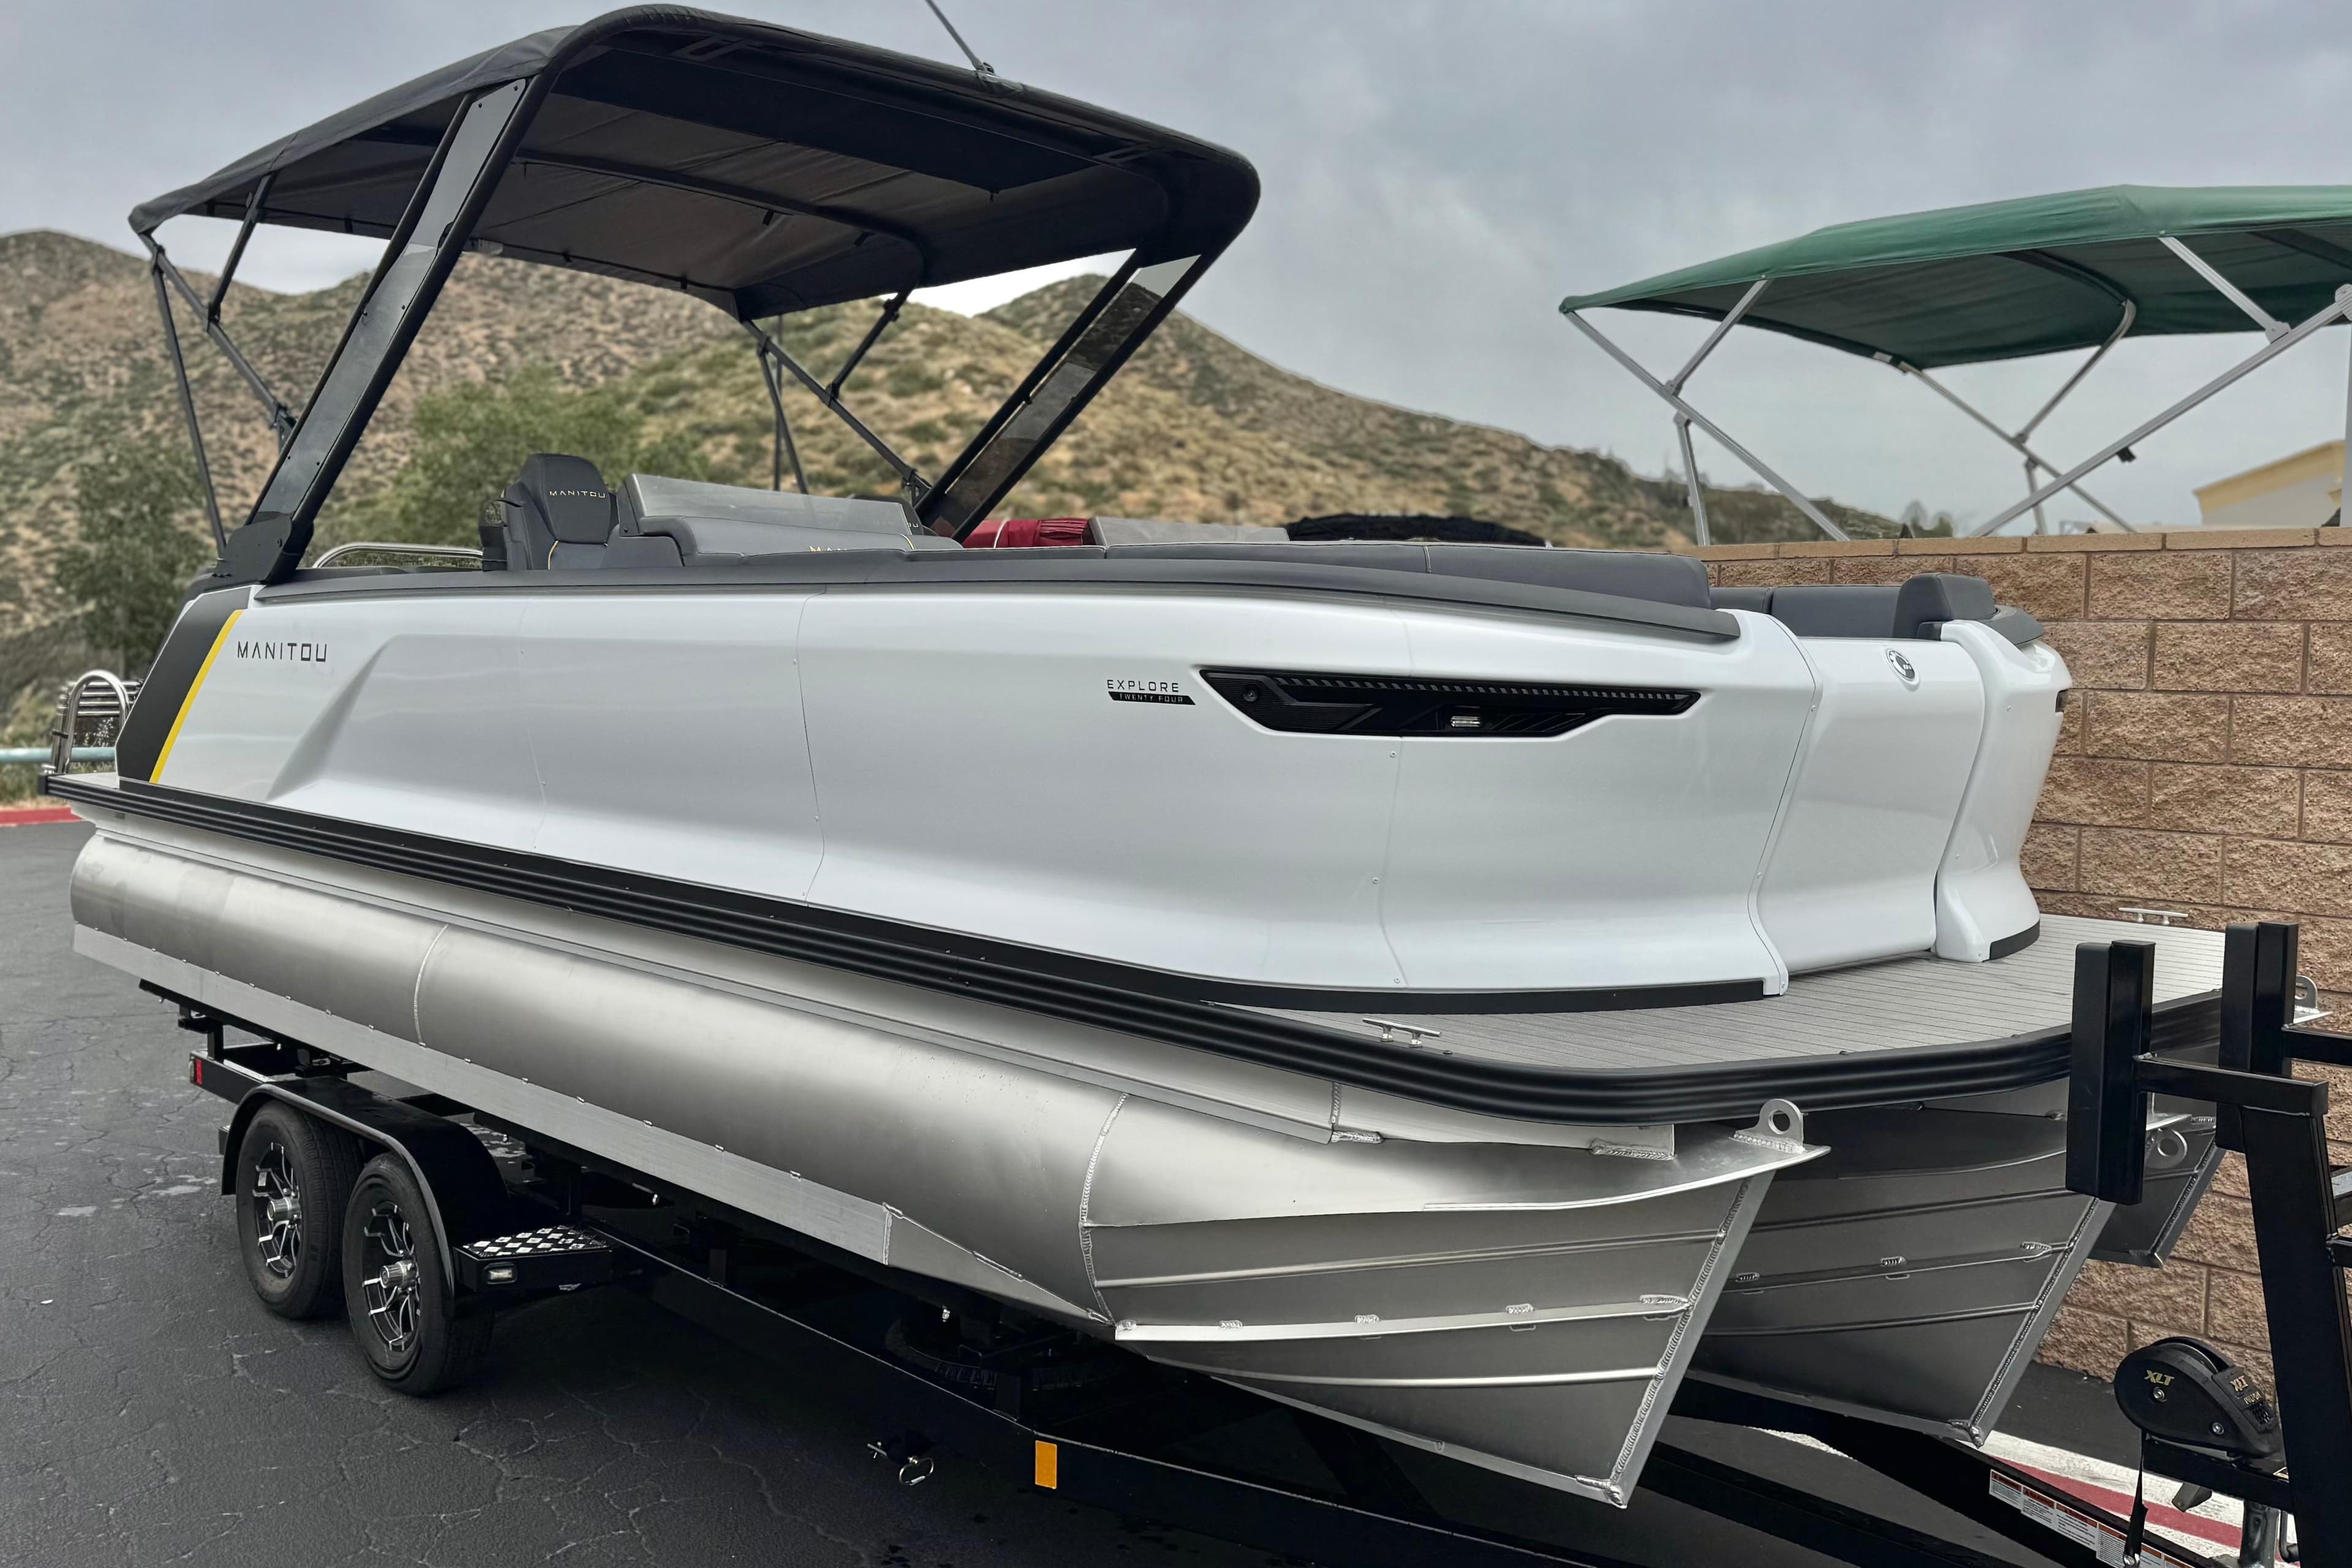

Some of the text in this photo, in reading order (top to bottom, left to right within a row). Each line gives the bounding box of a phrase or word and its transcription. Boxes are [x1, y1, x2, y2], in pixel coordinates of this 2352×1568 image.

[238, 641, 326, 662] MANITOU
[1107, 680, 1178, 692] EXPLORE
[2144, 1370, 2174, 1385] XLT
